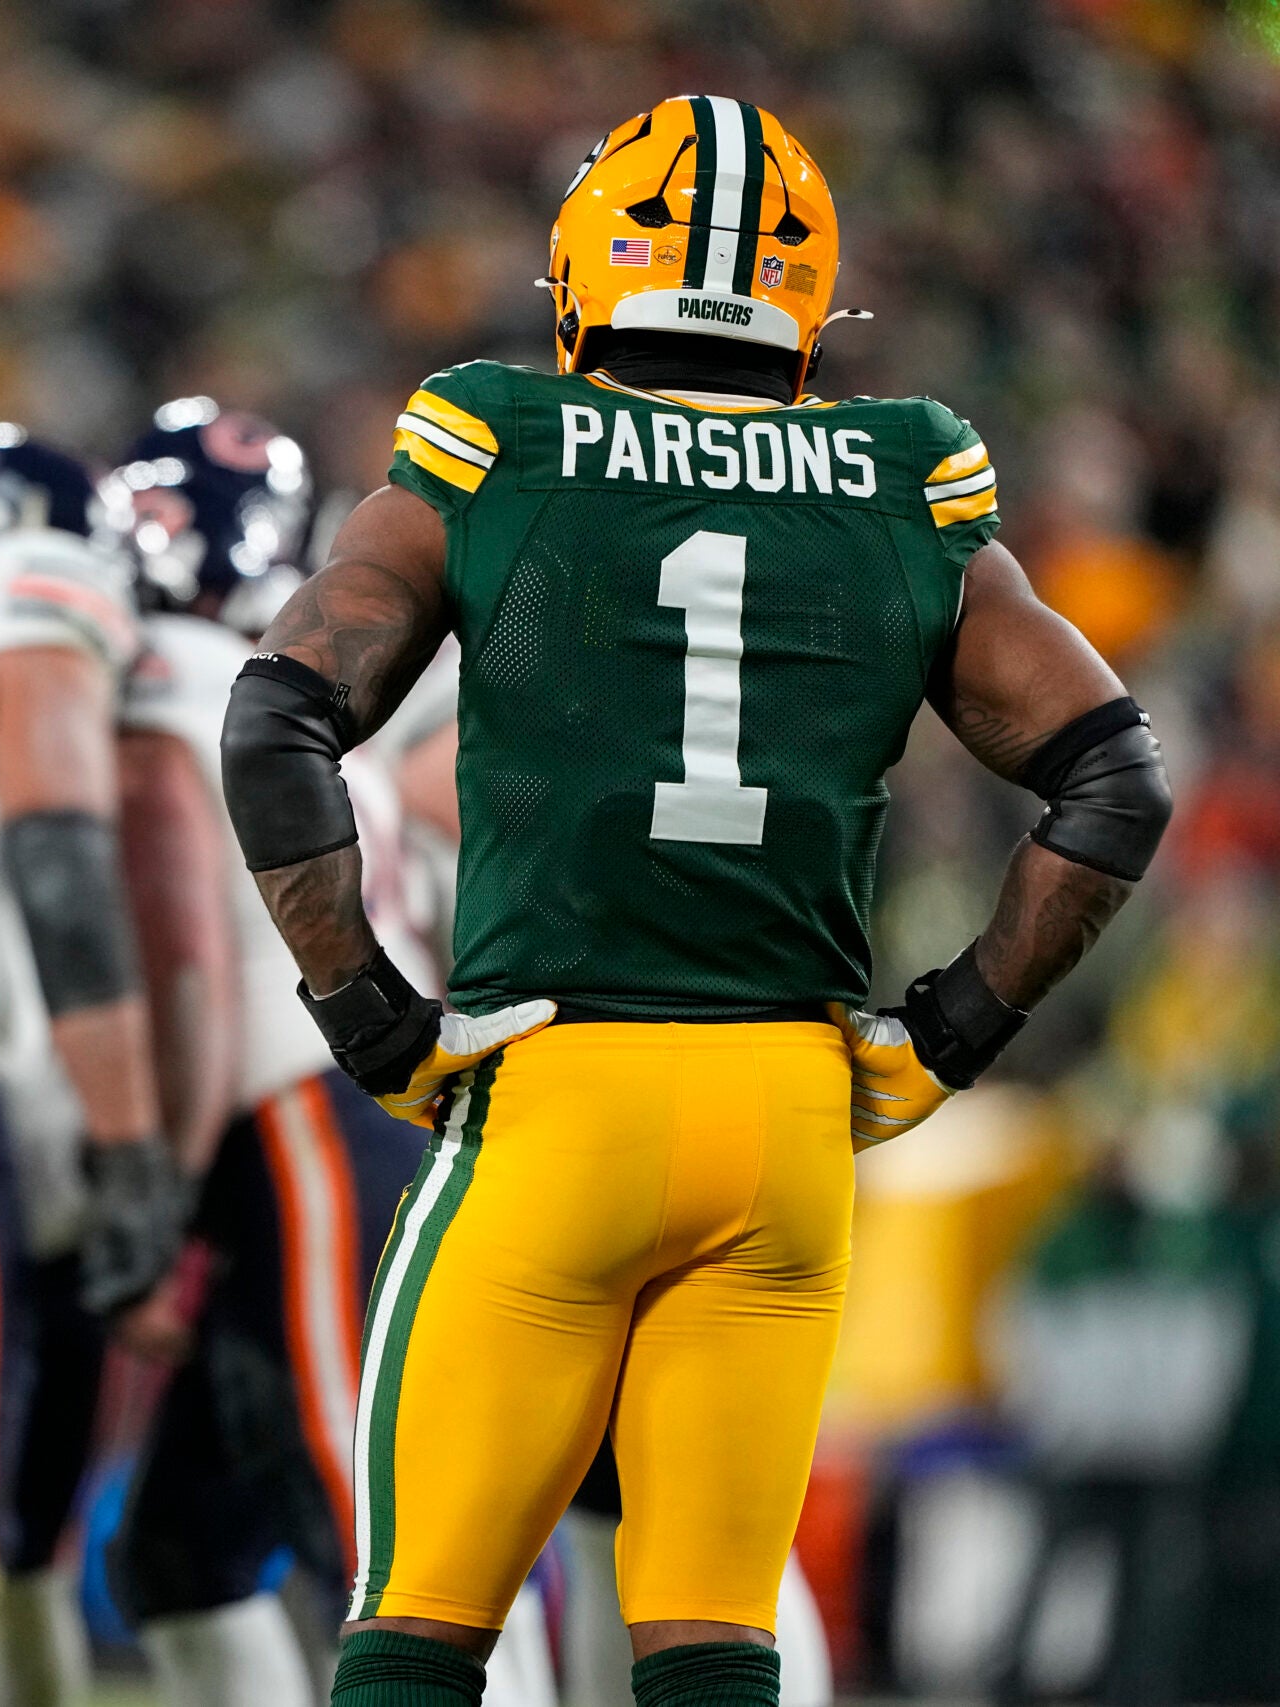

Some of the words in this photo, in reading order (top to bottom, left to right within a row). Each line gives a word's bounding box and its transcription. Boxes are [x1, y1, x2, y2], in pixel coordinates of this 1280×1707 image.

[762, 268, 779, 285] NFL
[678, 297, 754, 327] PACKERS
[561, 403, 877, 499] PARSONS
[649, 530, 768, 845] 1
